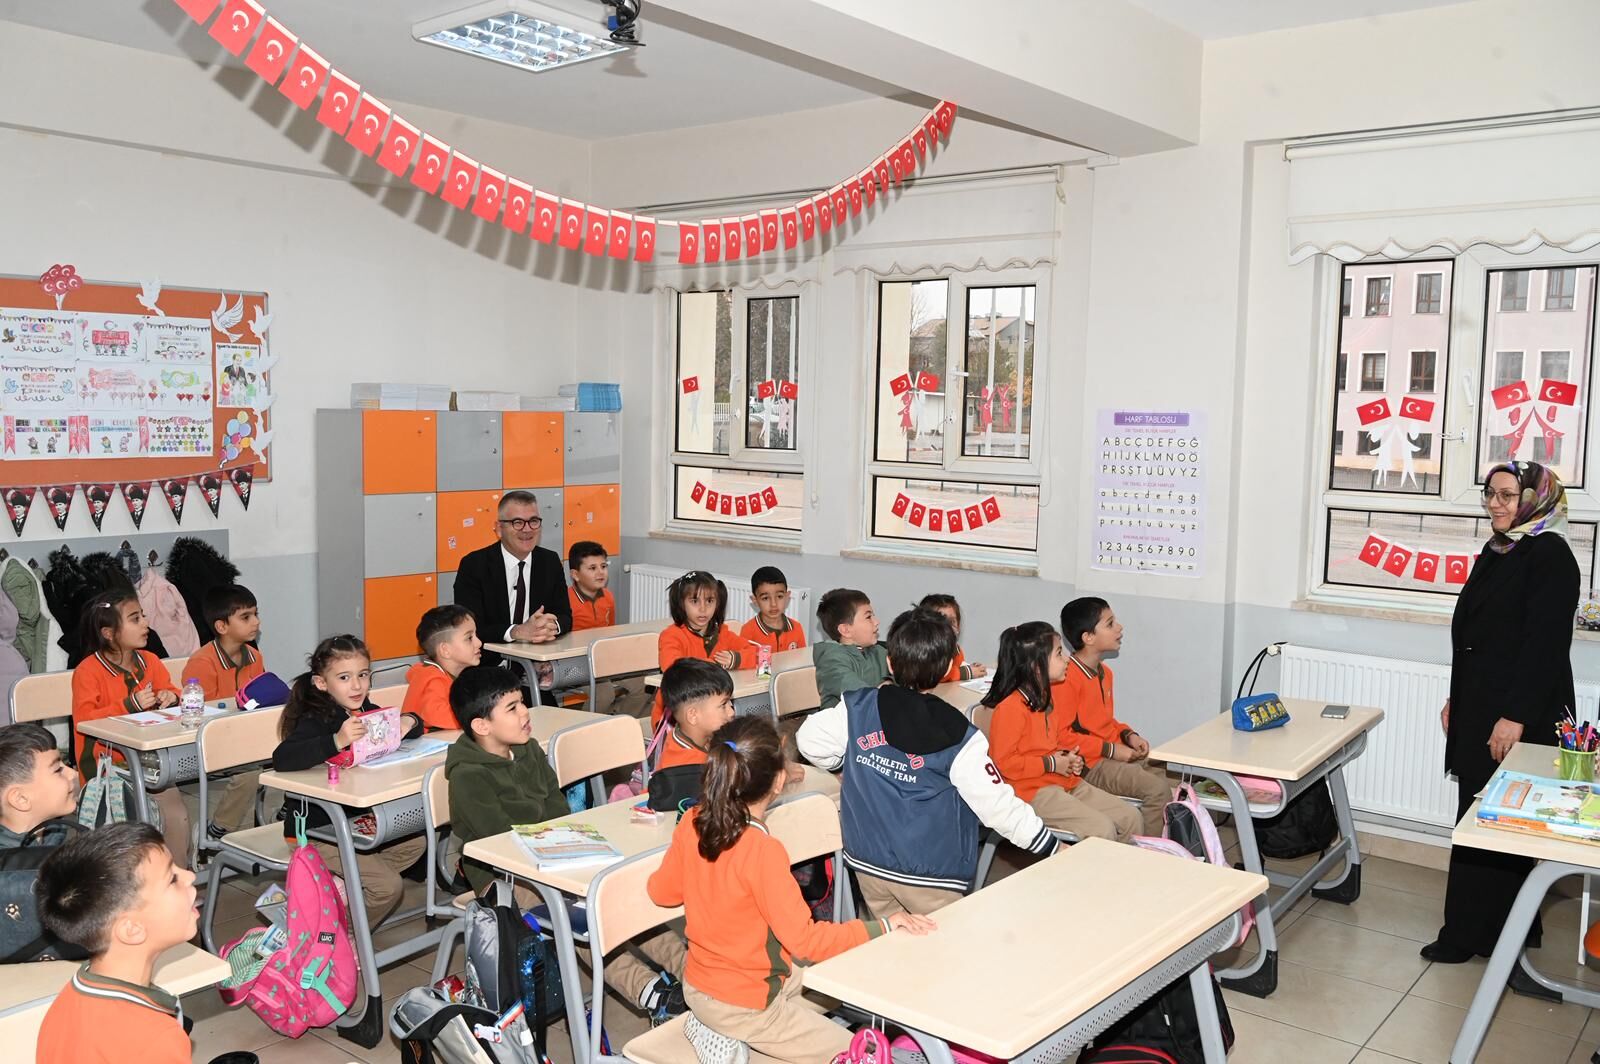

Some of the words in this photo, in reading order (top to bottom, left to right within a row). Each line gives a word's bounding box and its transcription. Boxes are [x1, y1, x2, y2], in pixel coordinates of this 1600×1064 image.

[1124, 415, 1143, 423] HARF
[1145, 416, 1177, 424] TABLOSU
[856, 755, 891, 776] COLLEGE
[894, 771, 917, 783] TEAM
[870, 753, 907, 771] ATHLETIC
